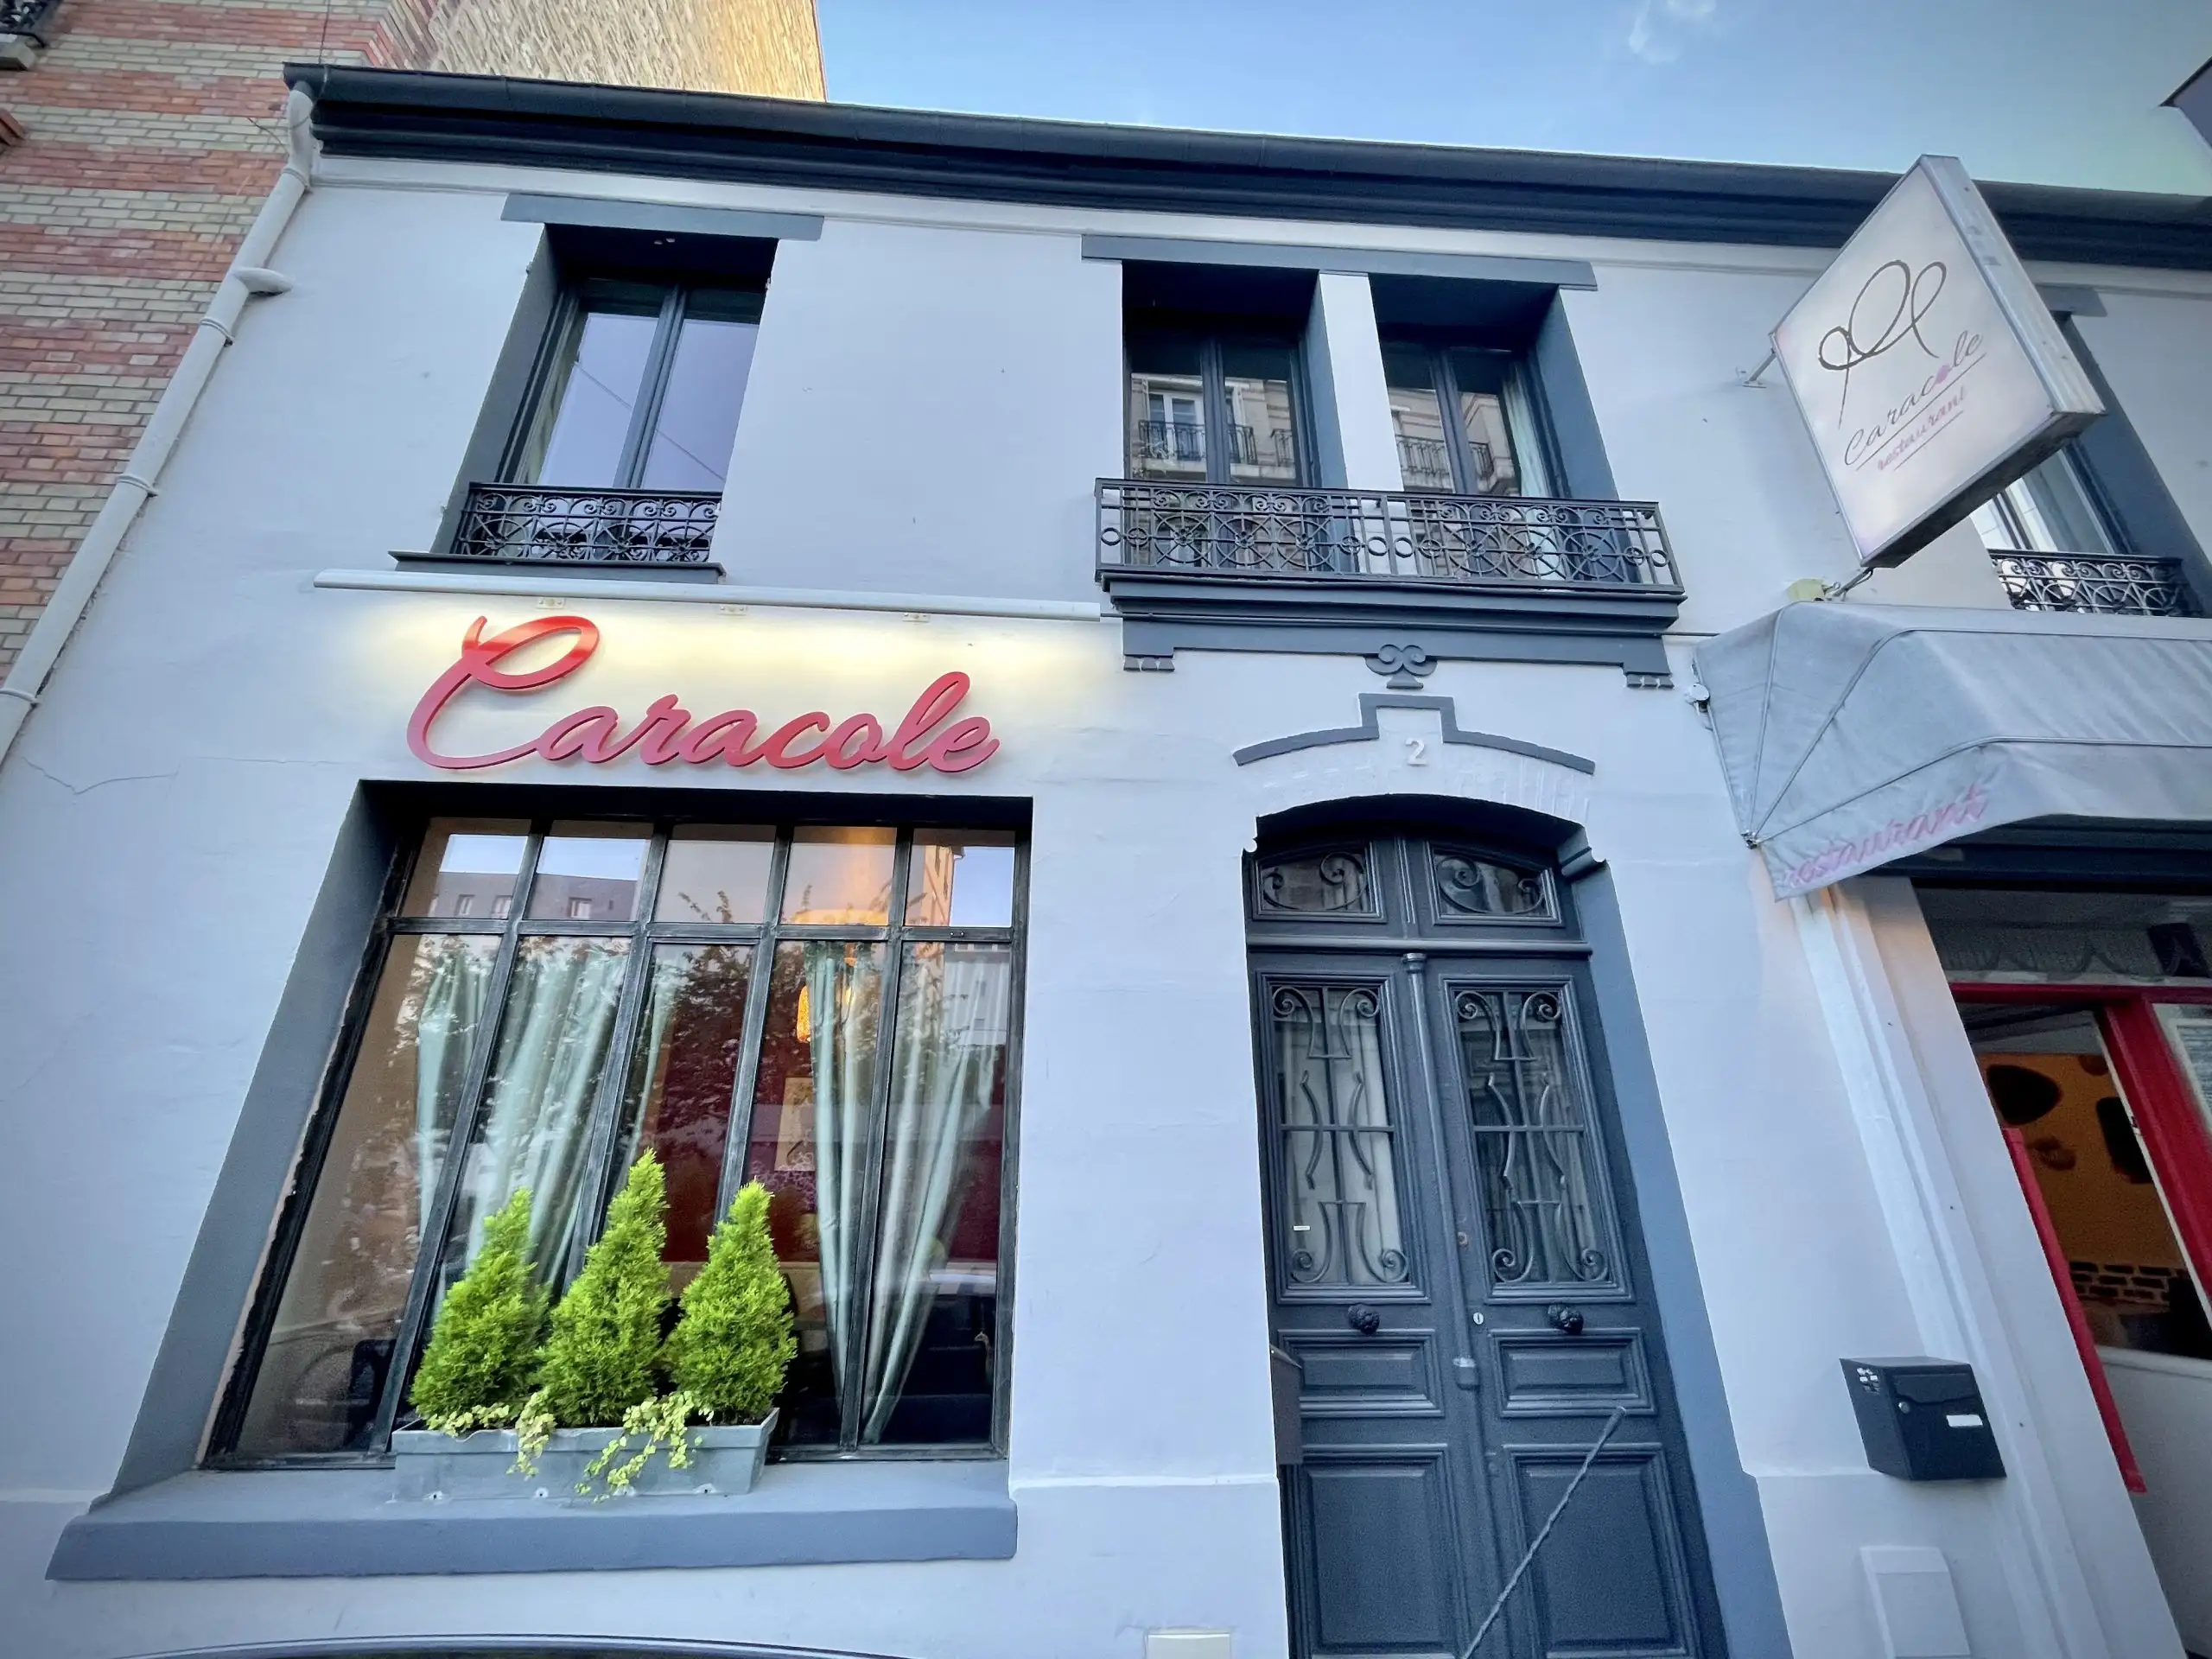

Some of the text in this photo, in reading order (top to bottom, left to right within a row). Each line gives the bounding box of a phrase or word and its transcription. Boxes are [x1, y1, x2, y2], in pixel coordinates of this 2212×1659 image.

[1845, 330, 1984, 466] Caracole
[405, 614, 1000, 772] Caracole
[1404, 736, 1428, 767] 2
